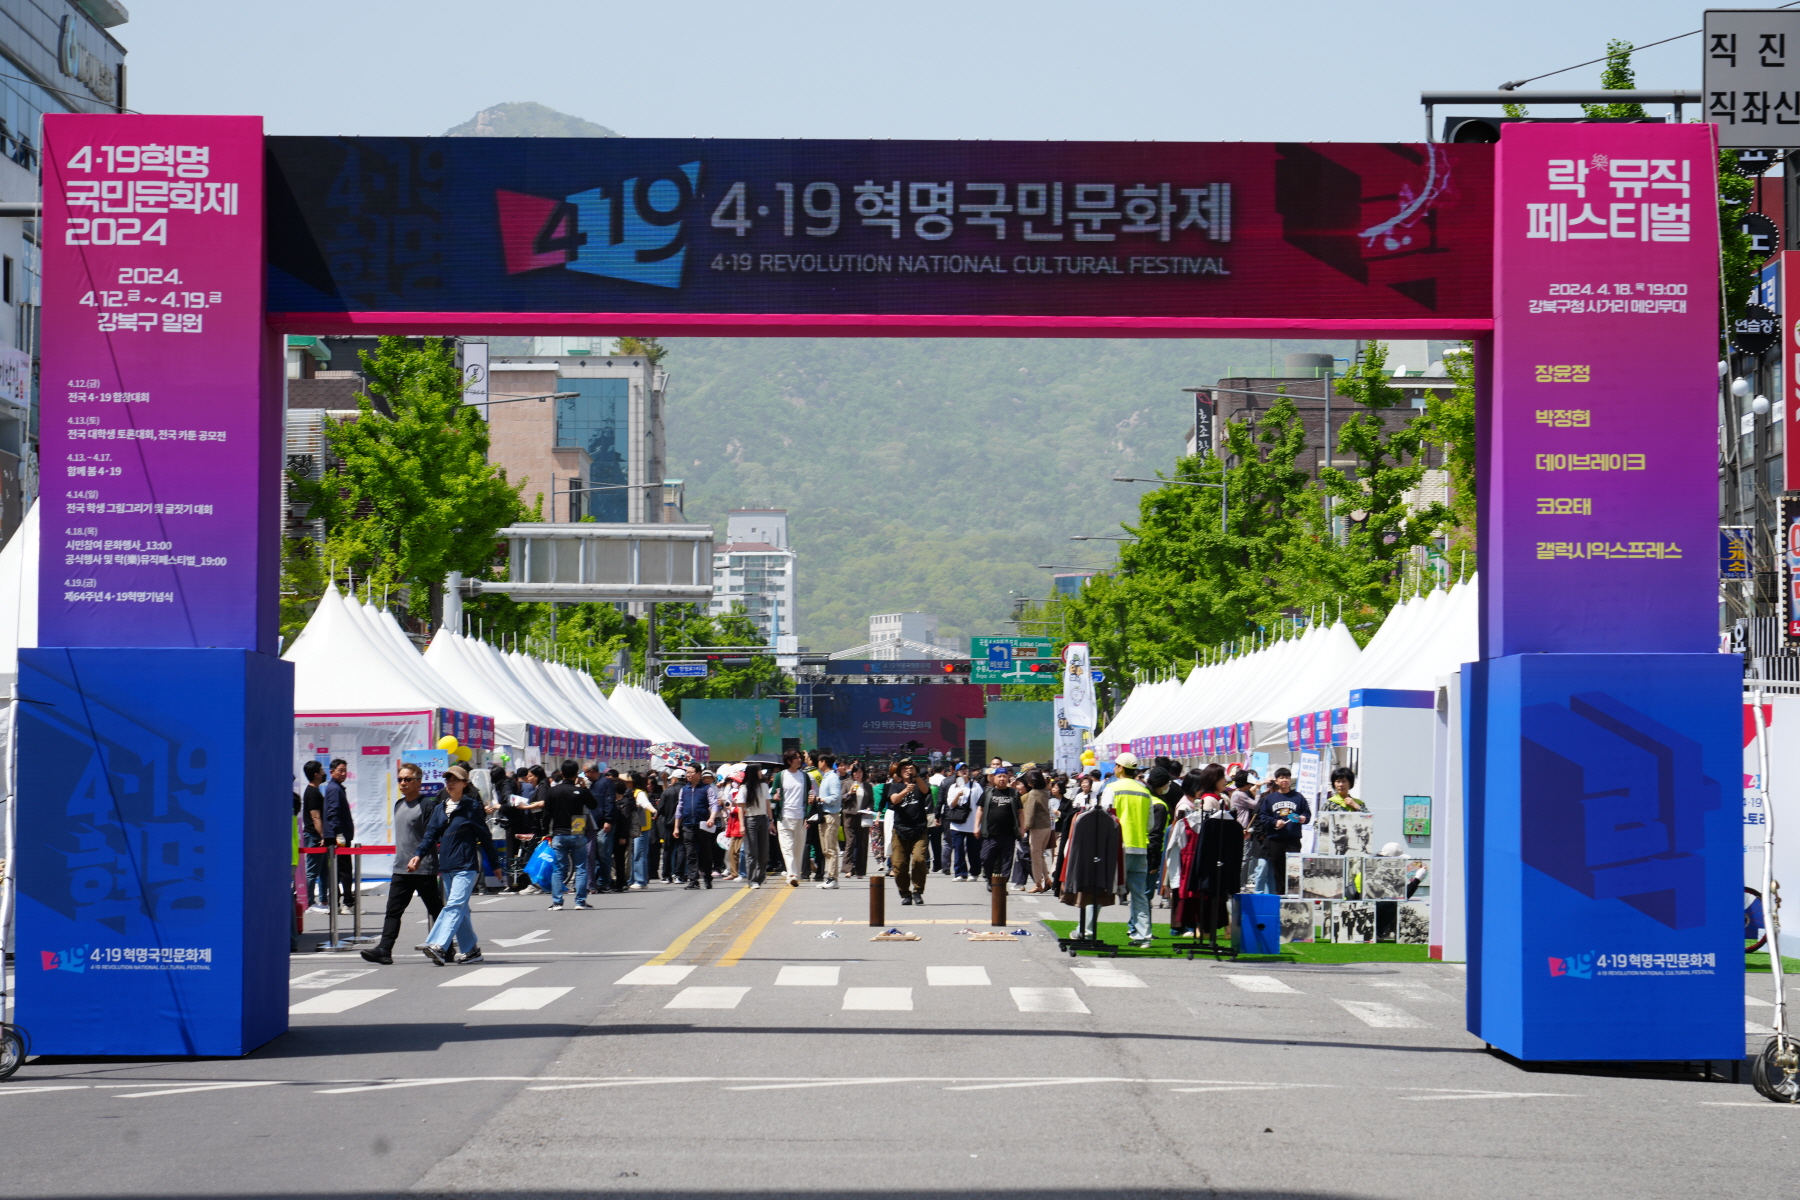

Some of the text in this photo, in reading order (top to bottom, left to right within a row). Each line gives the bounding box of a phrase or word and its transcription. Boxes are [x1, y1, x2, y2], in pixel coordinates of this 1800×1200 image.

[66, 143, 210, 178] 4·19혁명
[66, 181, 238, 215] 국민문화제
[710, 180, 1231, 242] 4·19 혁명국민문화제
[1526, 203, 1691, 242] 페스티벌
[65, 218, 167, 246] 2024
[760, 254, 892, 273] REVOLUTION
[899, 254, 1008, 274] NATIONAL
[1013, 255, 1124, 275] CULTURAL
[1129, 255, 1231, 275] FESTIVAL
[118, 268, 183, 285] 2024.
[1549, 284, 1594, 296] 2024.
[1647, 284, 1688, 296] 19:00
[1528, 299, 1687, 314] 강북구청 사거리 메인무대
[97, 313, 203, 333] 강북구 일원
[1735, 319, 1774, 333] 연습장
[1535, 365, 1590, 383] 장윤정
[67, 379, 100, 389] 4.12.(금)
[67, 392, 87, 403] 전국
[113, 392, 150, 403] 합창대회
[67, 416, 100, 426] 4.13.(토)
[1536, 409, 1591, 427] 박정현
[67, 429, 226, 441] 전국 대학생 토론대회, 전국 카툰 공모전
[1536, 453, 1646, 471] 데이브레이크
[67, 466, 86, 477] 함께
[87, 466, 97, 476] 봄
[66, 490, 98, 500] 4.14.(일)
[66, 503, 213, 515] 전국 학생 그림그리기 및 글짓기 대회
[1536, 498, 1592, 515] 코요태
[65, 540, 102, 551] 시민참여
[1536, 542, 1682, 560] 갤럭시익스프레스
[65, 554, 102, 565] 공식행사
[103, 554, 113, 565] 및
[1728, 538, 1748, 572] 소개소
[64, 579, 97, 589] 4.19.(금)
[64, 592, 103, 603] 제64주년
[990, 660, 1011, 669] 비보호
[882, 721, 932, 729] 혁명국민문화제
[90, 948, 212, 963] 4·19 혁명국민문화제
[1597, 953, 1716, 968] 4·19 혁명국민문화제
